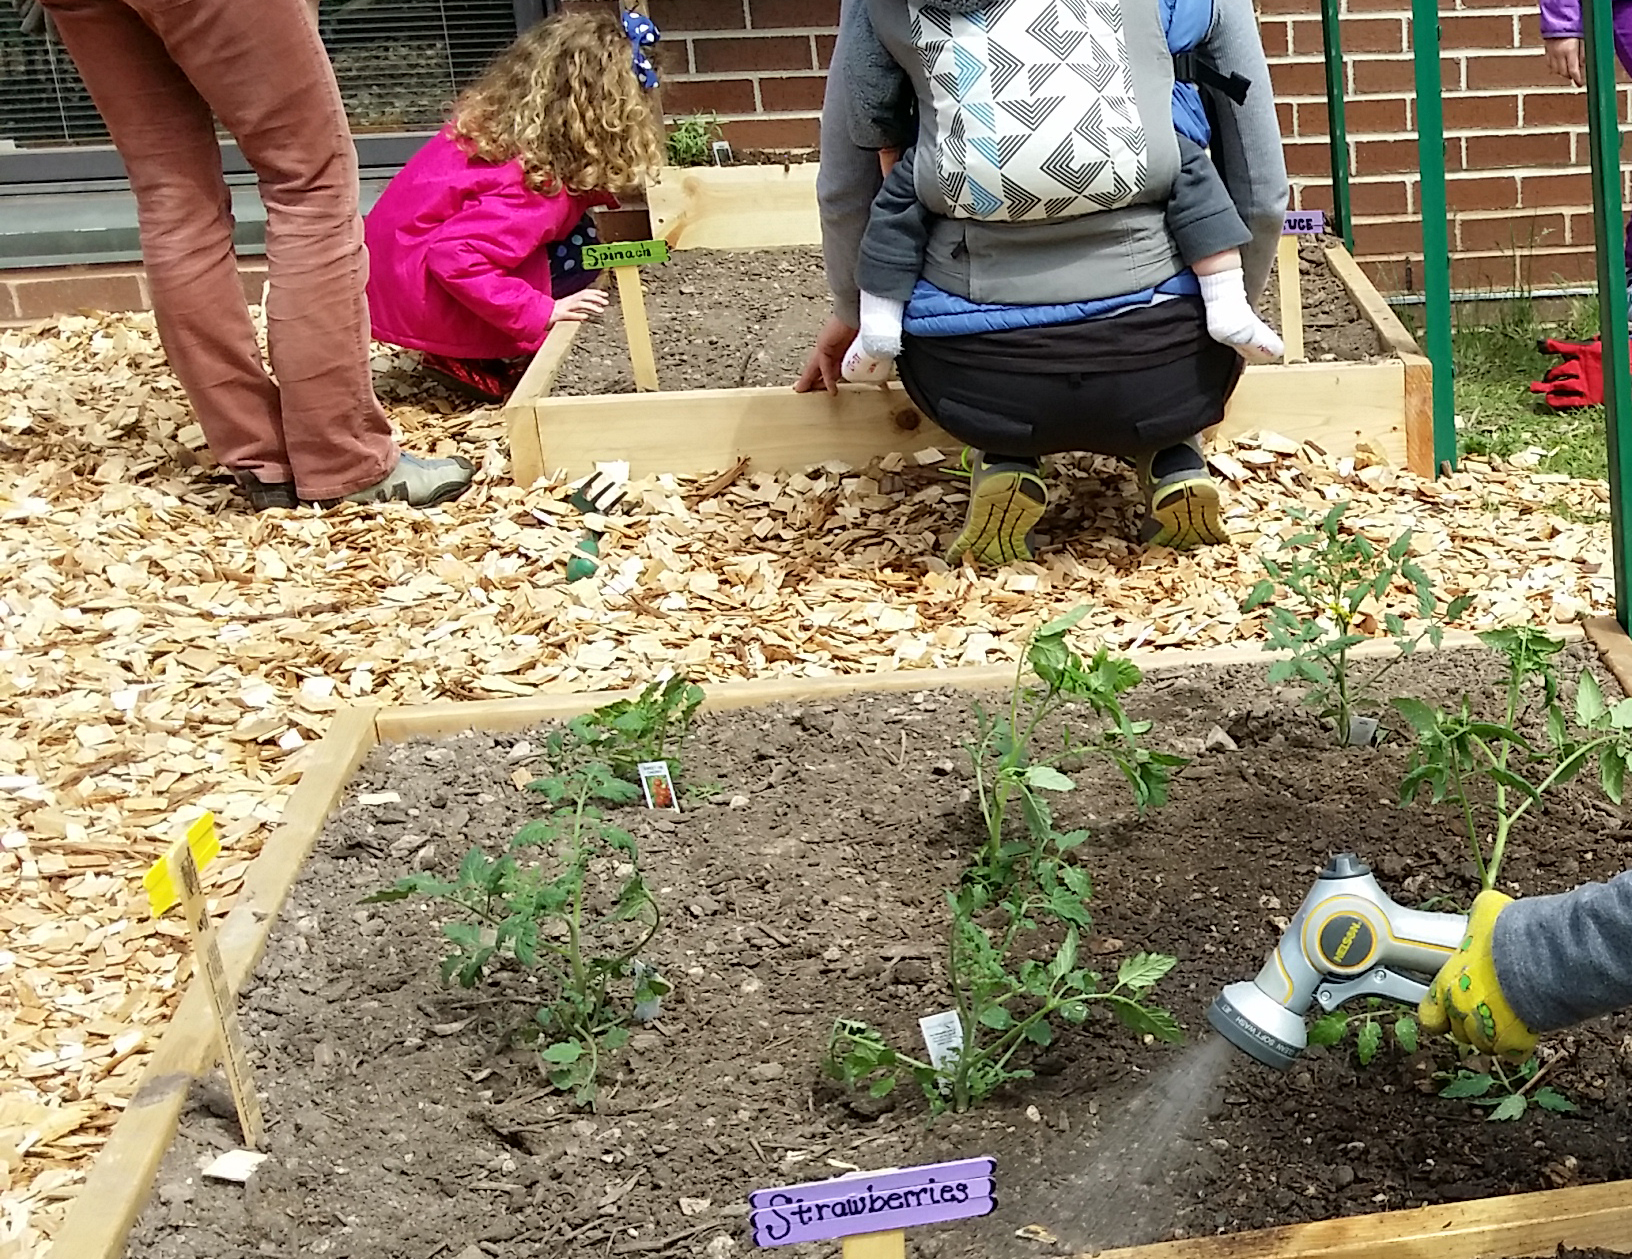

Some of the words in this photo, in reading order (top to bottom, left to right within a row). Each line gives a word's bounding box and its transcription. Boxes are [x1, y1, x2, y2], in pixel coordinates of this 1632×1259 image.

[1284, 218, 1313, 231] UCE
[586, 243, 652, 267] Spinach
[1333, 922, 1361, 963] NELSON
[1235, 1015, 1257, 1035] WASH
[1255, 1031, 1276, 1047] SOFT
[765, 1177, 970, 1240] Strawberries
